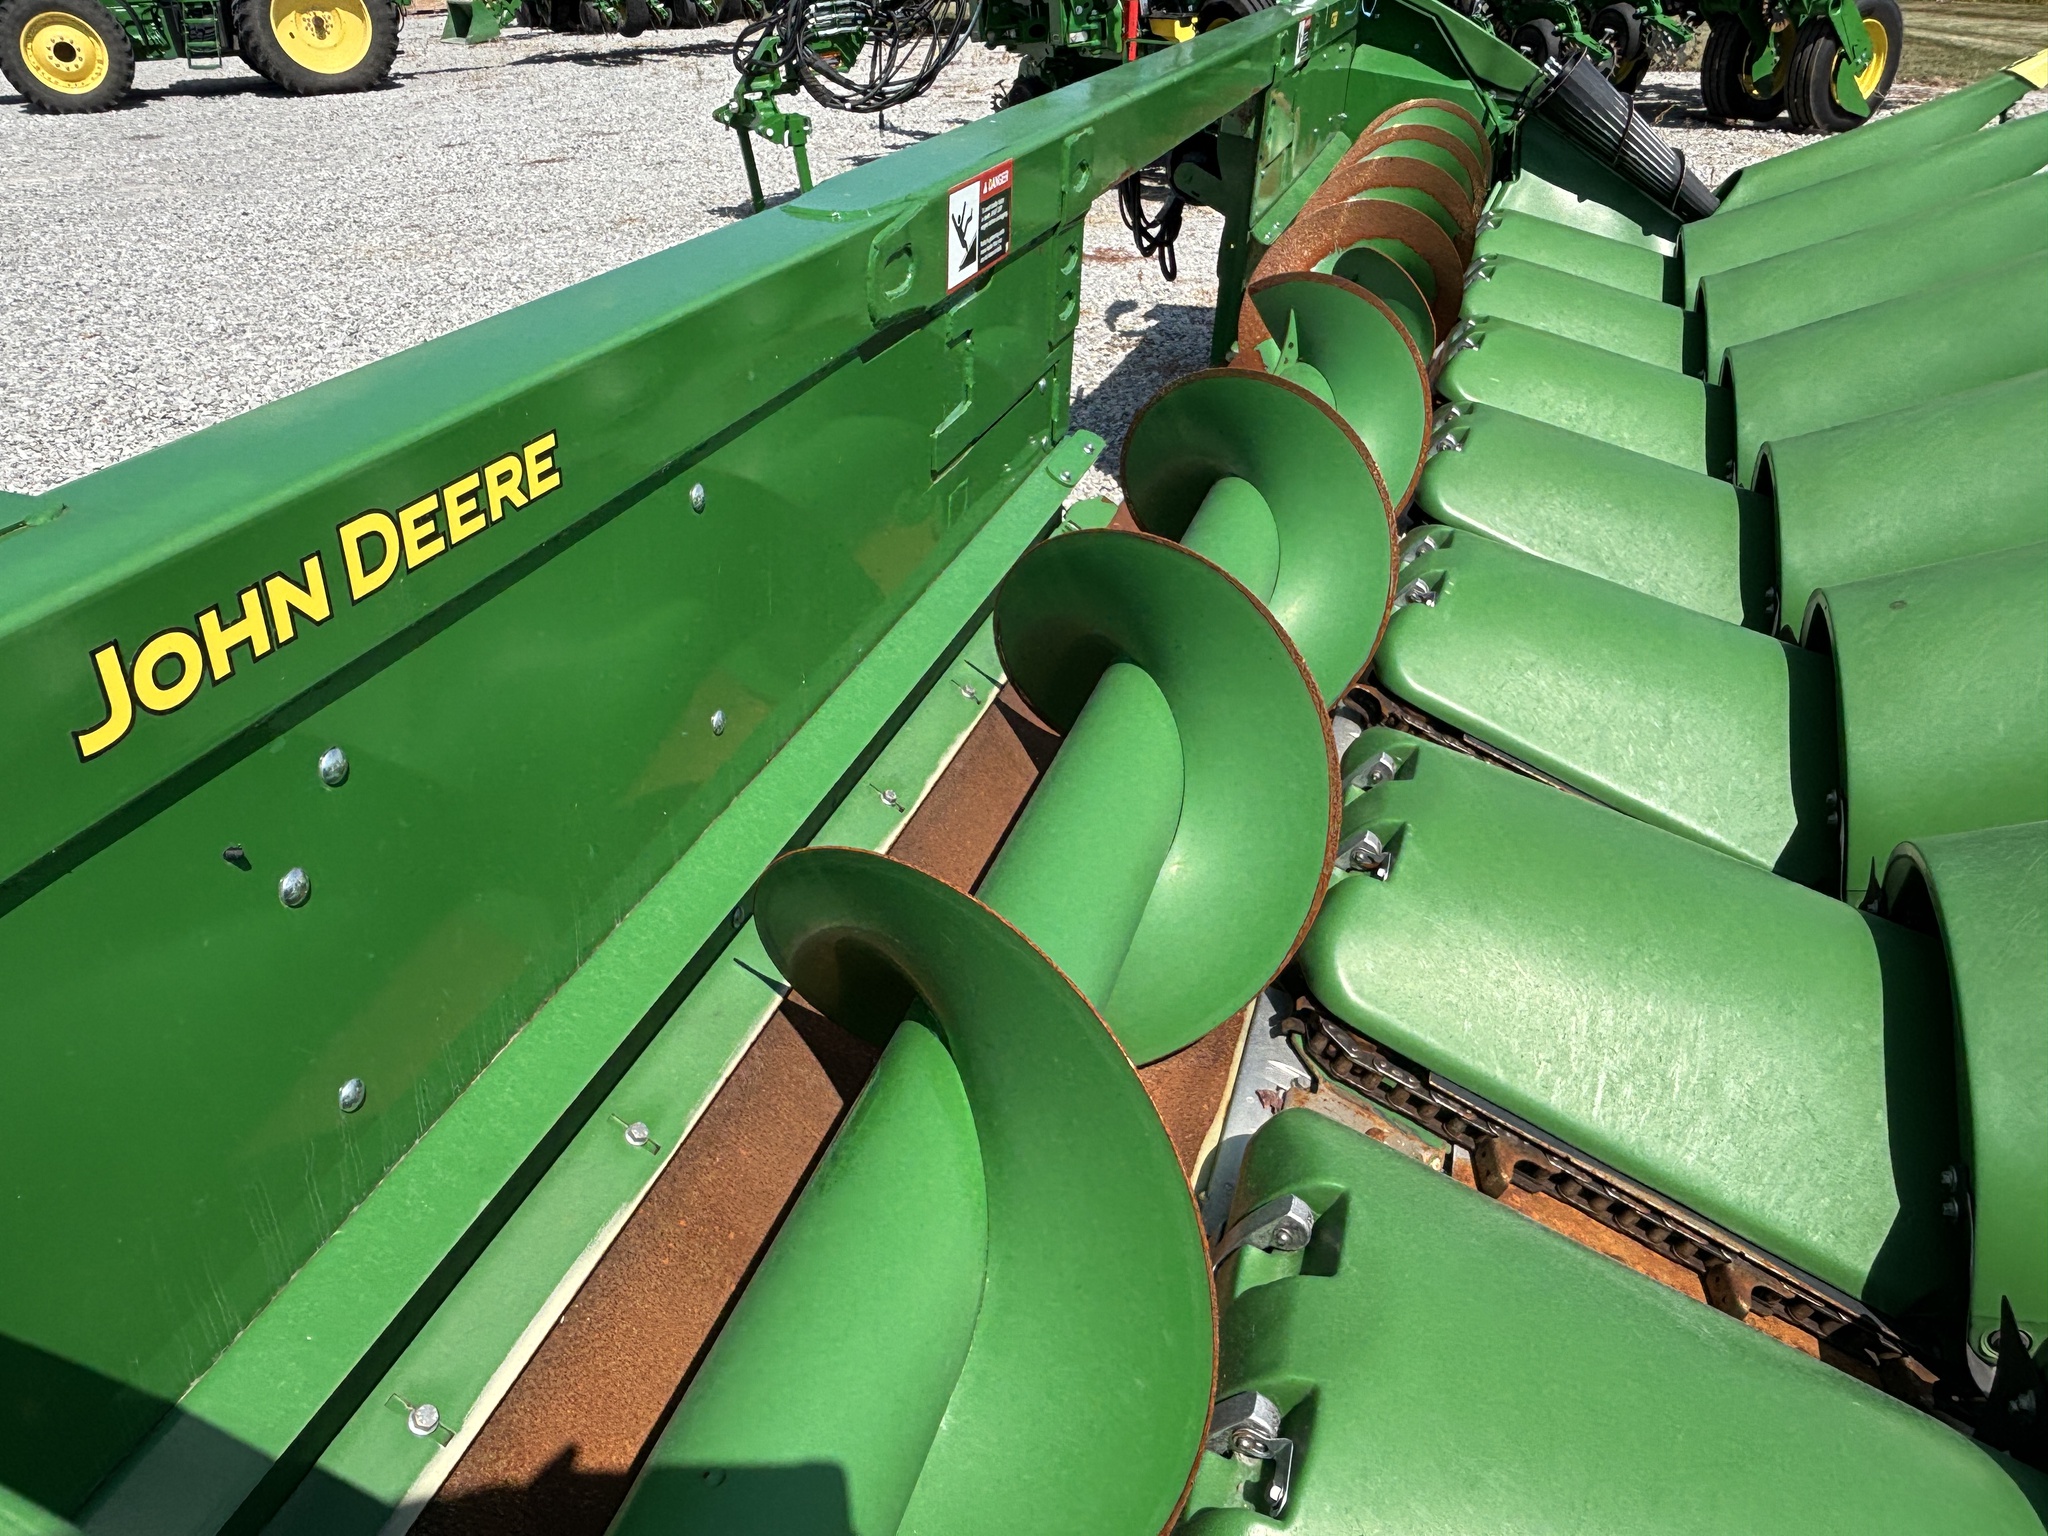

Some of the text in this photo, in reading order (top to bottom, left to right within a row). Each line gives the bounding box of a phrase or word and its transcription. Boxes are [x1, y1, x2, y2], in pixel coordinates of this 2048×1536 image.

[988, 169, 1009, 192] DANGER
[75, 431, 562, 758] JOHN DEERE
